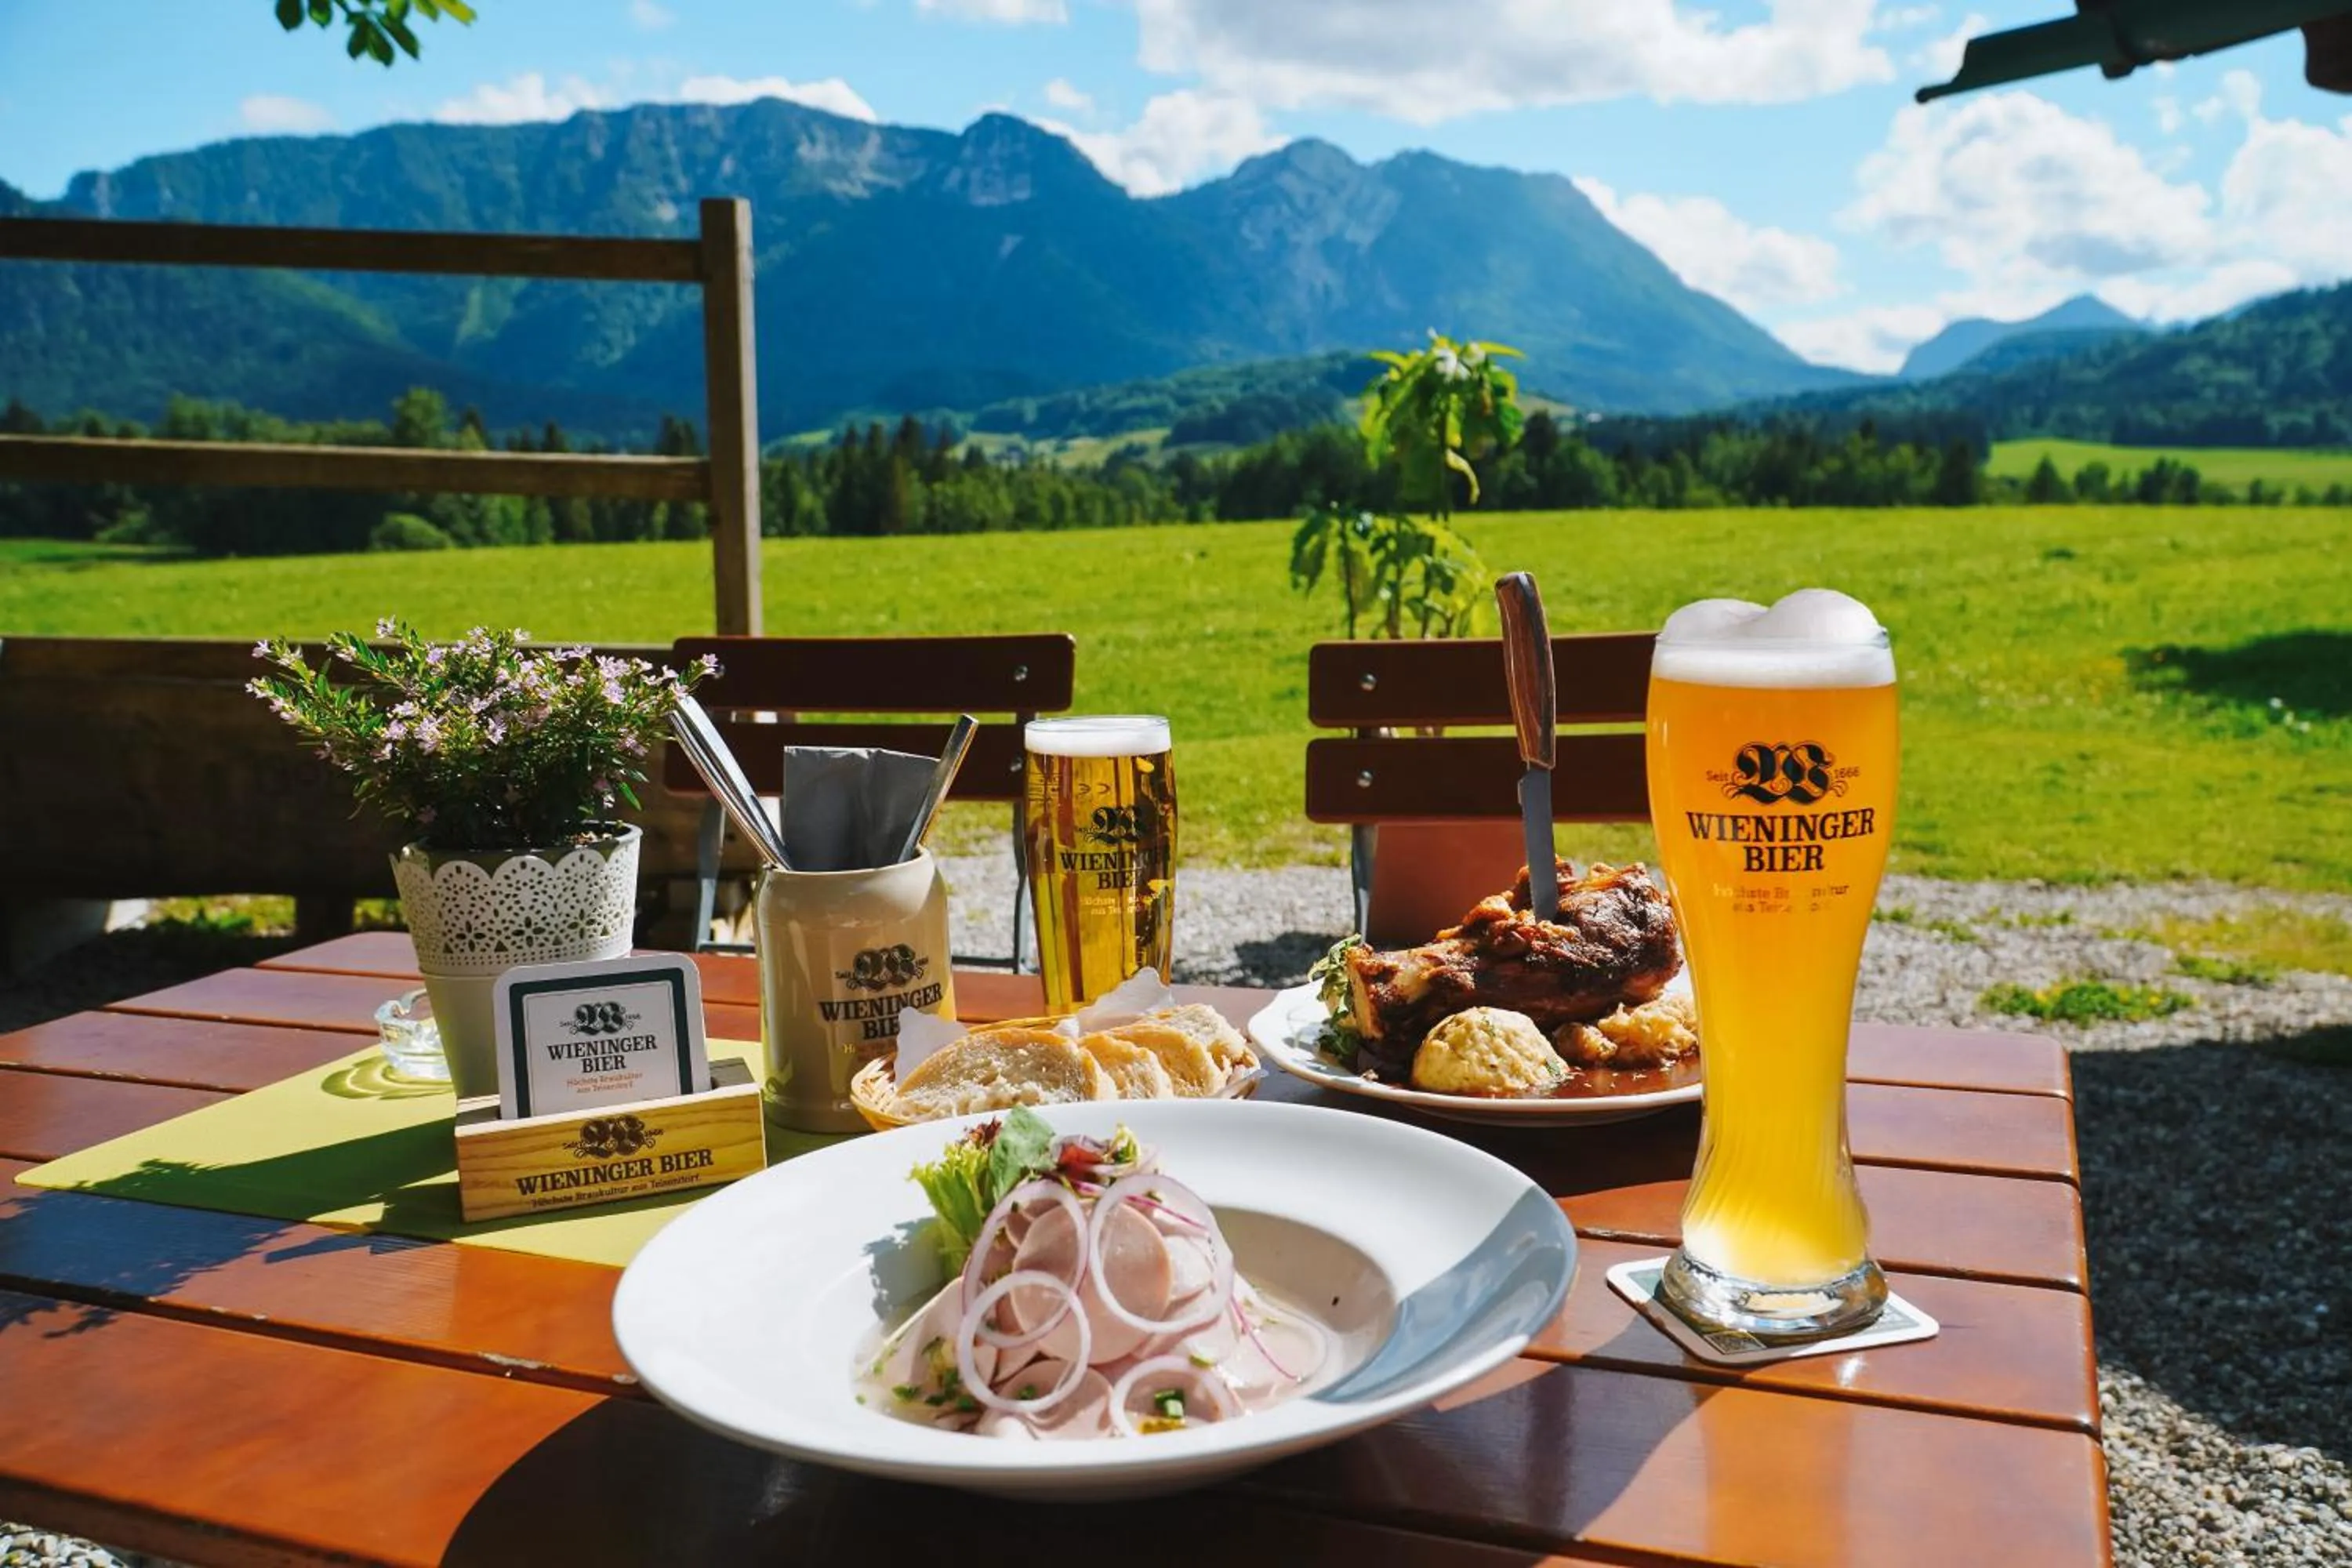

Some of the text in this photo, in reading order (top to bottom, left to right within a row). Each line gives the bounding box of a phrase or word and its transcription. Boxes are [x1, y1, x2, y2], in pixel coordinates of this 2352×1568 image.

[1706, 770, 1729, 782] Seit
[1686, 808, 1875, 843] WIENINGER
[1744, 844, 1824, 873] BIER
[818, 982, 943, 1022] WIENINGER
[861, 1016, 900, 1040] BIE
[547, 1035, 657, 1060] WIENINGER
[583, 1054, 626, 1073] BIER
[516, 1149, 714, 1196] WIENINGER BIER
